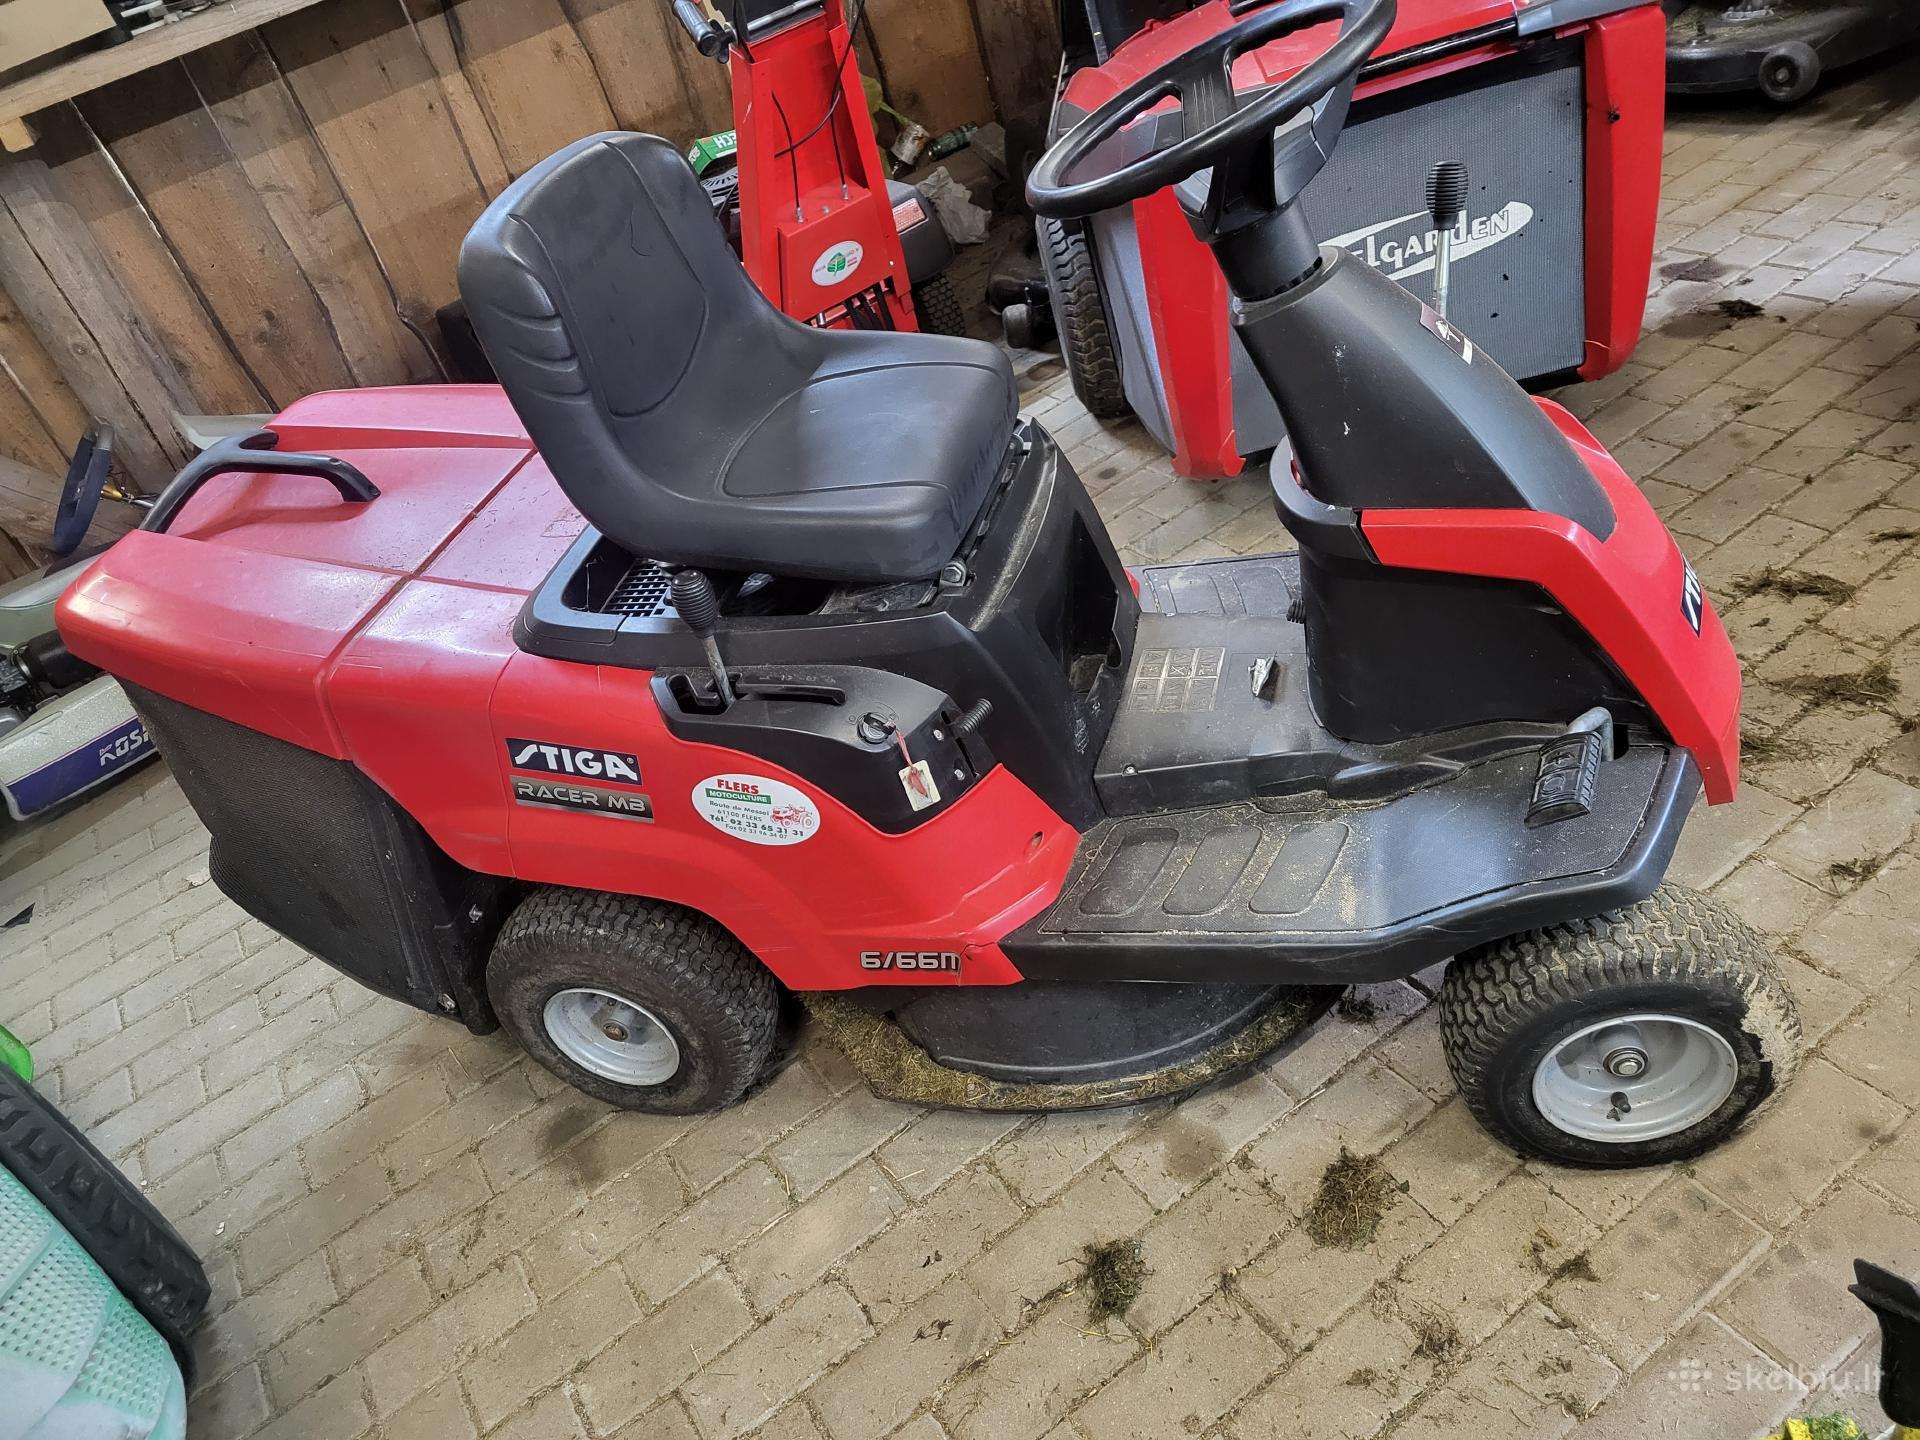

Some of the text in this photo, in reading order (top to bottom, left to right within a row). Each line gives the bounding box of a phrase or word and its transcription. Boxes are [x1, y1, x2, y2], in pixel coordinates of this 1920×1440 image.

[514, 743, 639, 782] STIGA
[517, 782, 600, 806] RACER
[717, 779, 759, 795] FLERS
[709, 790, 768, 803] MOTOCULTURE
[741, 813, 762, 822] FLERS
[730, 818, 742, 826] 02
[745, 821, 758, 829] 33
[760, 824, 773, 832] 65
[776, 827, 788, 835] 31
[792, 829, 804, 837] 31
